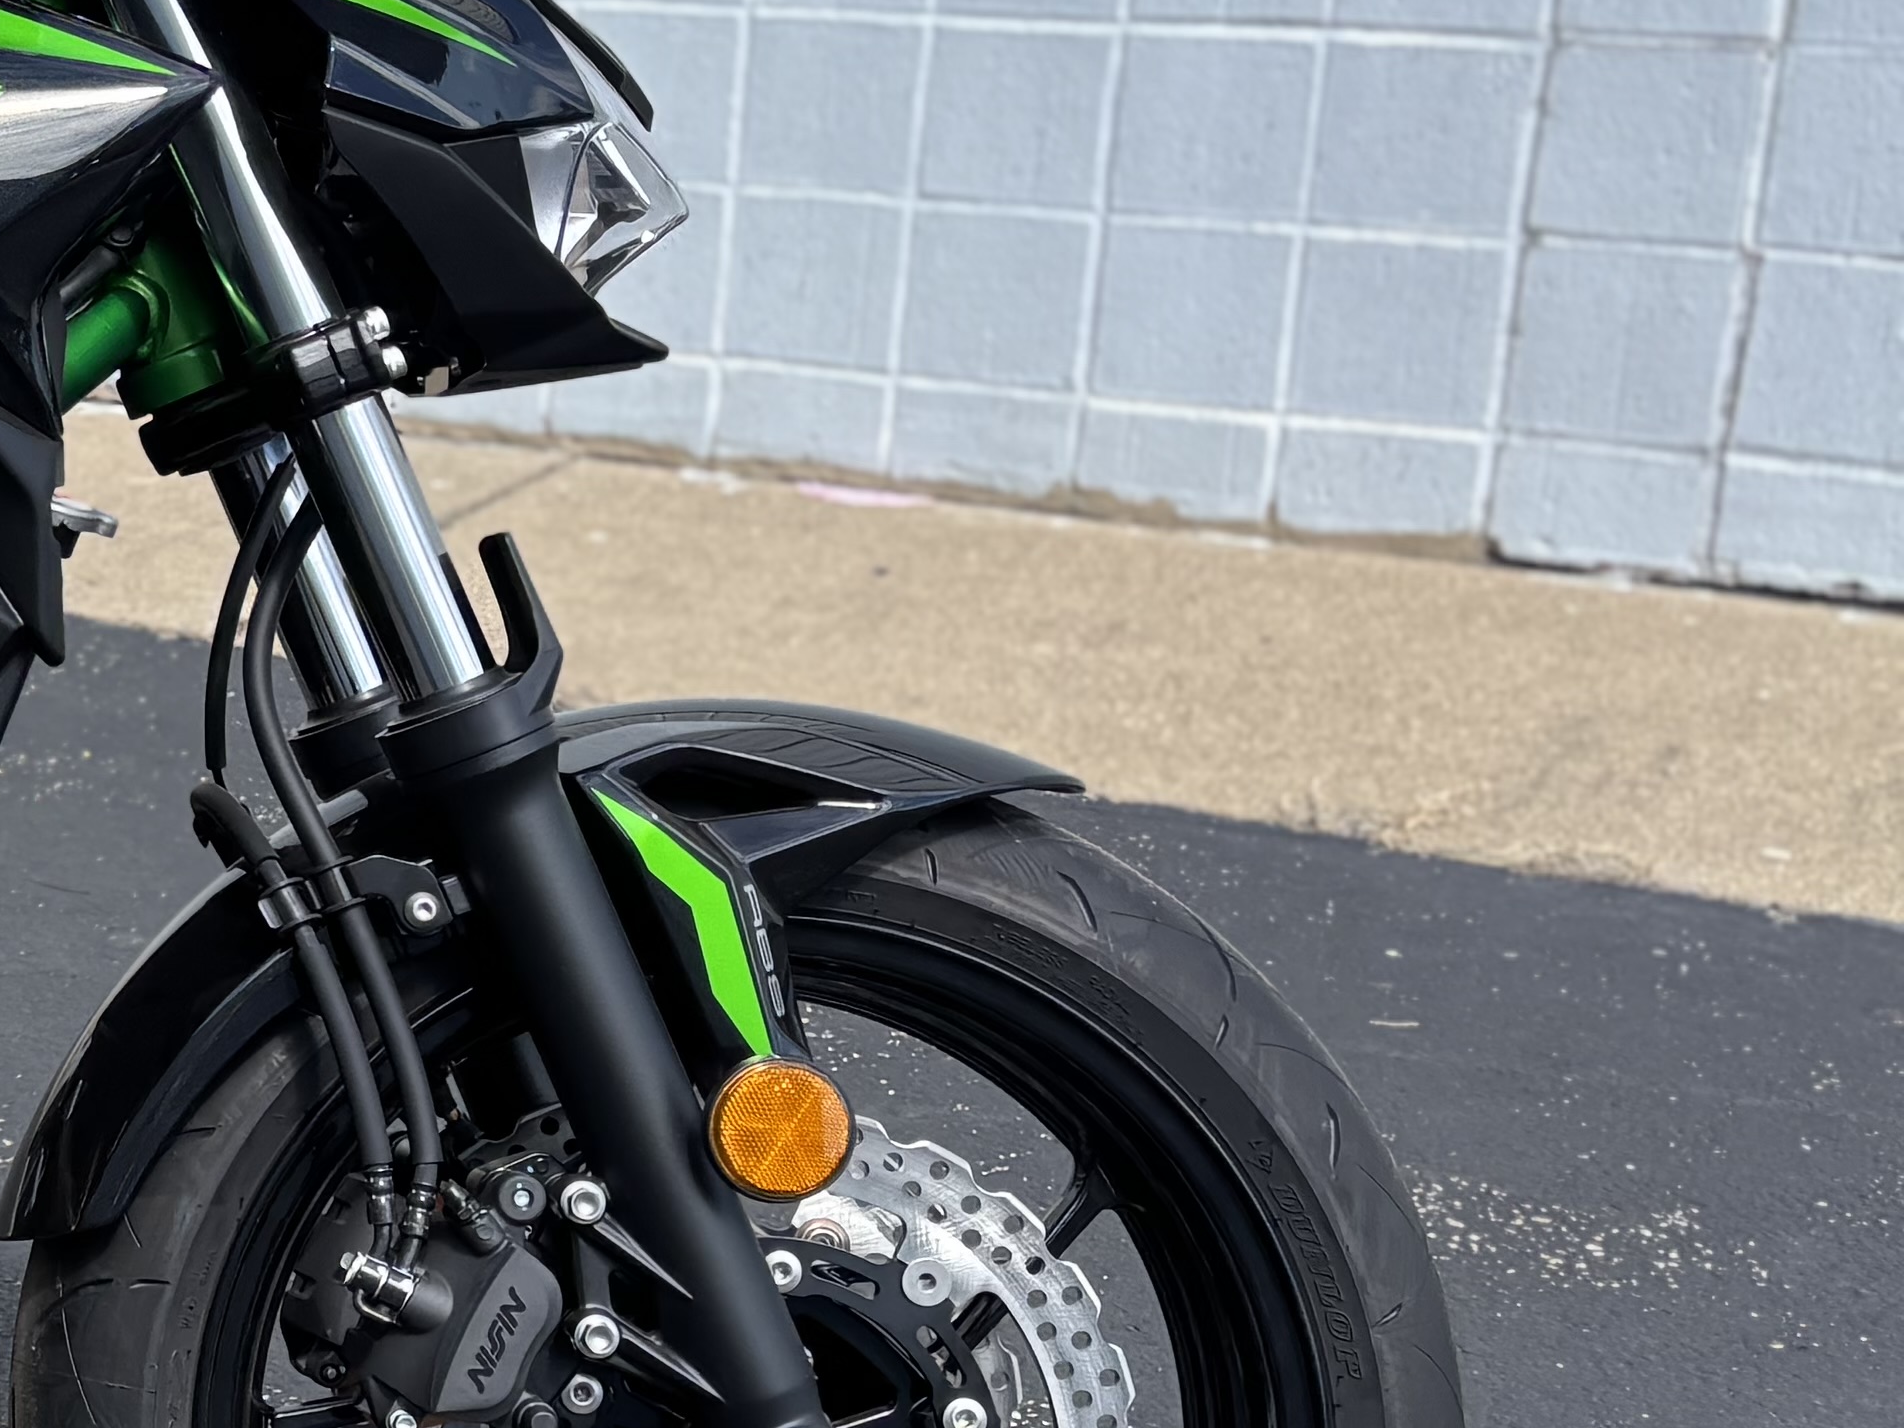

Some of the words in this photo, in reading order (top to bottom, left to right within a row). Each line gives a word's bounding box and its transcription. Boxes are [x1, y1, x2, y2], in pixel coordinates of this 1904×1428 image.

[743, 883, 786, 1018] ABS
[467, 1285, 527, 1394] NISSIN
[1268, 1183, 1362, 1380] DUNLOP
